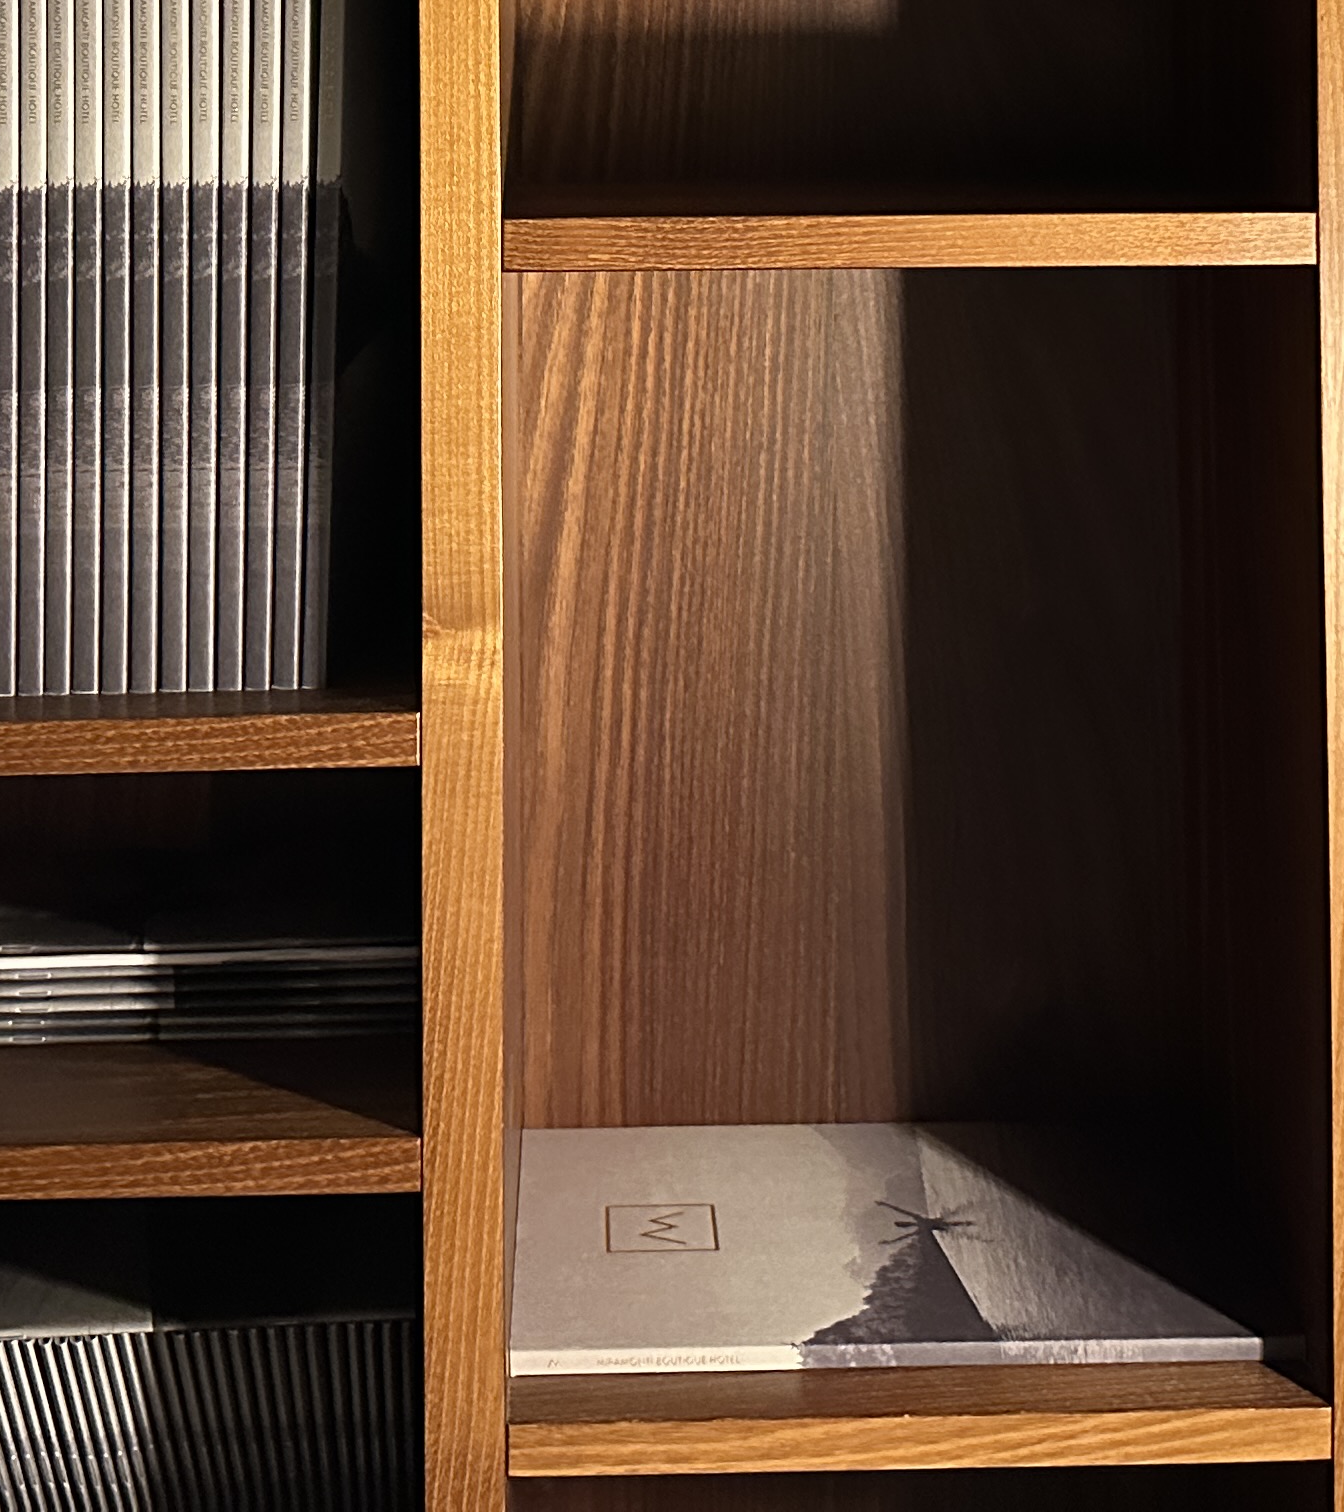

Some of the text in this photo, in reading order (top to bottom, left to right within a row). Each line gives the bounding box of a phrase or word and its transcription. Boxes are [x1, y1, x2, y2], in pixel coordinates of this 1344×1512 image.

[0, 42, 7, 92] BOUTIQUE
[28, 42, 37, 91] BOUTIQUE
[53, 41, 62, 92] BOUTIQUE
[81, 42, 90, 92] BOUTIQUE
[111, 41, 120, 90] BOUTIQUE
[139, 41, 148, 90] BOUTIQUE
[169, 42, 177, 91] BOUTIQUE
[199, 39, 207, 89] BOUTIQUE
[230, 41, 239, 90] BOUTIQUE
[260, 41, 269, 90] BOUTIQUE
[291, 40, 299, 89] BOUTIQUE
[0, 95, 7, 125] HOTEL
[28, 95, 37, 125] HOTEL
[53, 94, 62, 124] HOTEL
[81, 95, 90, 124] HOTEL
[111, 93, 120, 124] HOTEL
[139, 94, 147, 125] HOTEL
[169, 94, 177, 125] HOTEL
[199, 93, 207, 123] HOTEL
[230, 93, 239, 124] HOTEL
[260, 94, 269, 124] HOTEL
[290, 93, 299, 121] HOTEL
[656, 1354, 706, 1366] BOUTIQUE
[709, 1353, 740, 1365] HOTEL
